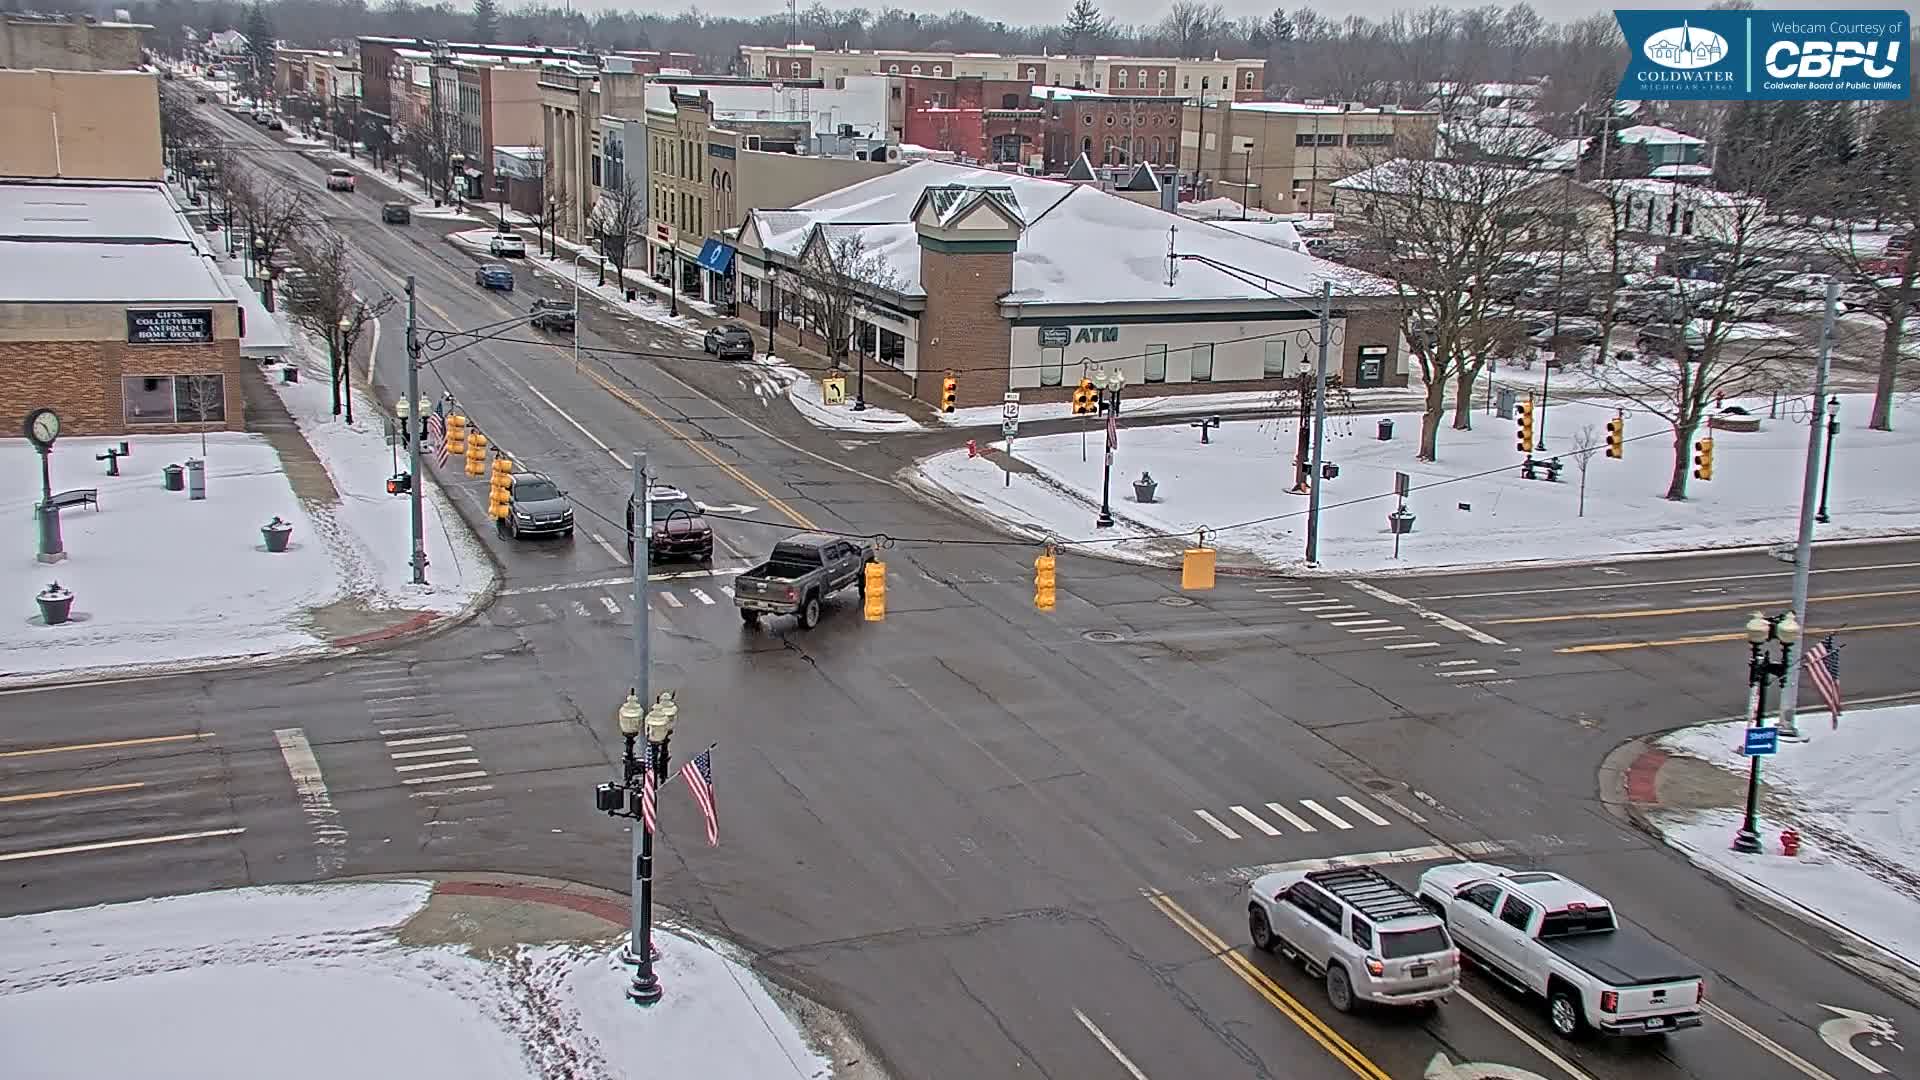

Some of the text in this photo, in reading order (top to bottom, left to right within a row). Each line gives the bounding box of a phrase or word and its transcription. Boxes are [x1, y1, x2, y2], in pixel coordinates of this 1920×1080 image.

[138, 331, 167, 339] HOME
[1075, 327, 1119, 343] ATM
[1006, 405, 1017, 415] 12
